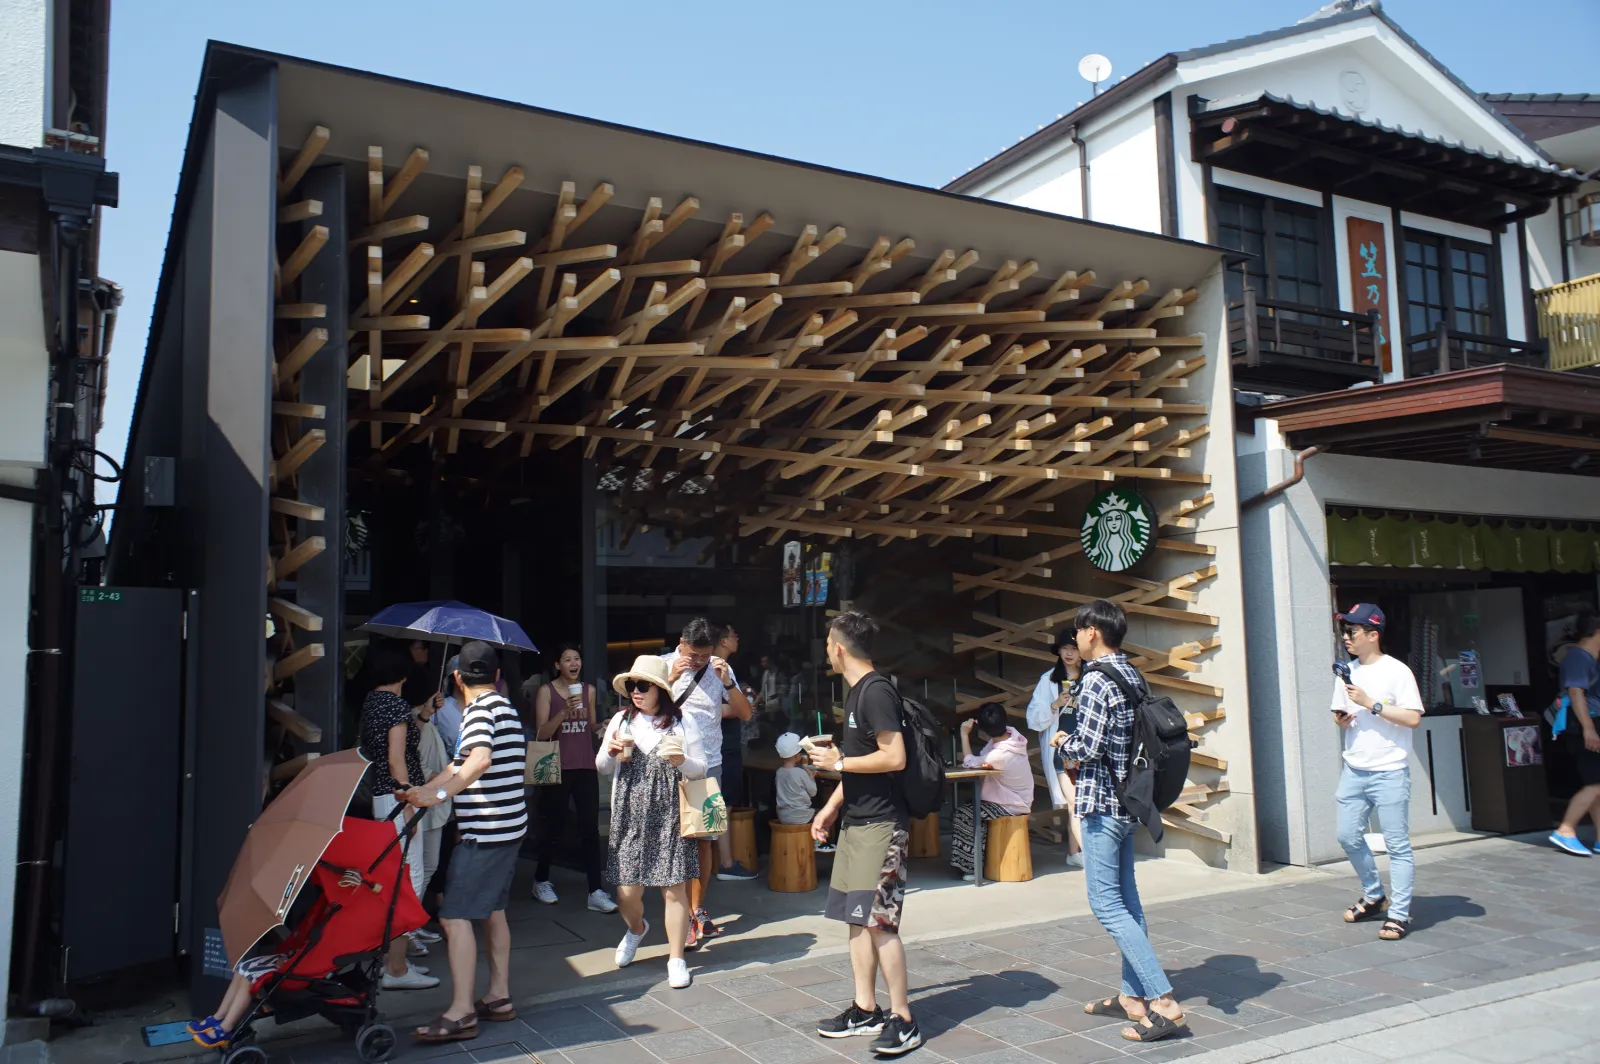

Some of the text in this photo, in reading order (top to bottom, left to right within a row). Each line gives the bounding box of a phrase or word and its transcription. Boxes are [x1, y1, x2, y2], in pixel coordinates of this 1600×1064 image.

[98, 592, 120, 601] 2-43
[563, 708, 587, 719] UN
[561, 721, 588, 733] DAY
